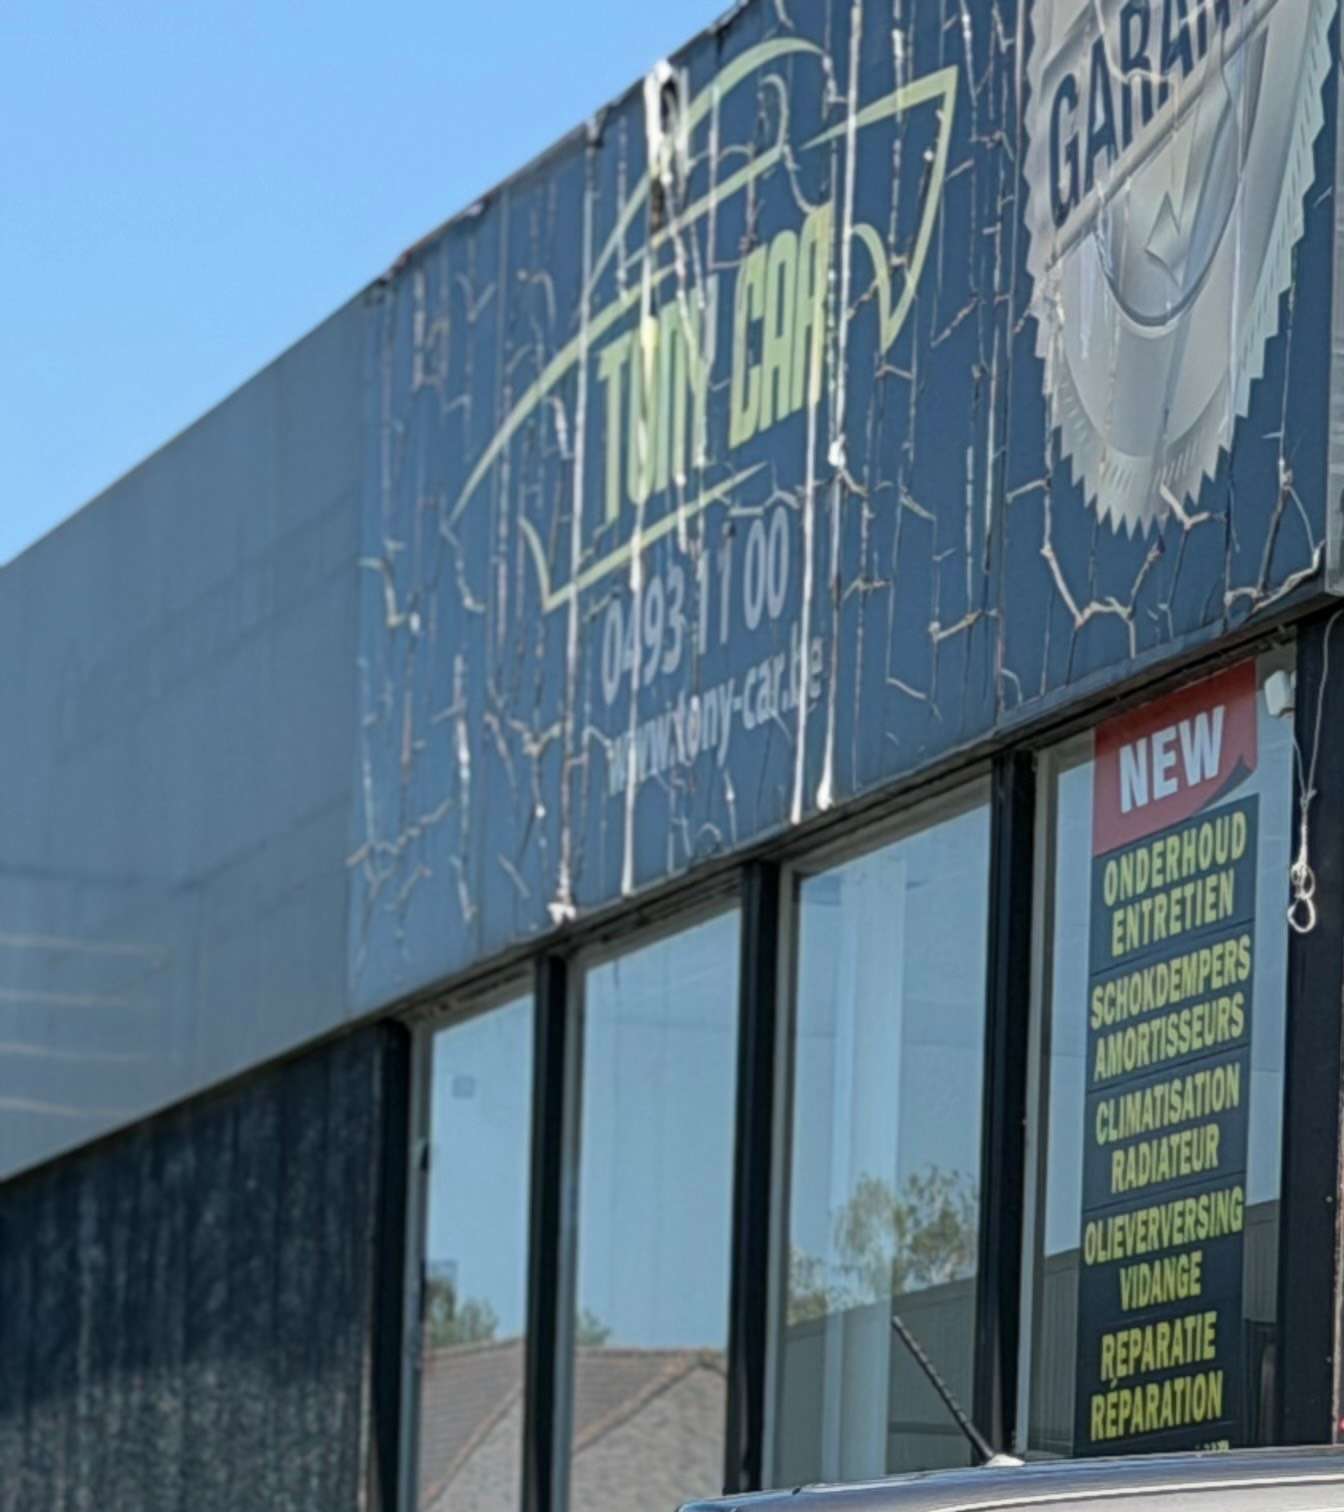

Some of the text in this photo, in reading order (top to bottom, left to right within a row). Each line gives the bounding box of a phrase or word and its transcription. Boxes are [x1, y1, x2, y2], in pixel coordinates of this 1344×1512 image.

[598, 202, 833, 525] TONY CAR
[1118, 705, 1225, 813] NEW
[1103, 811, 1247, 907] ONDERHOUD
[1112, 869, 1236, 957] ENTRETIEN
[1090, 934, 1252, 1030] SCHOKDEMPERS
[1094, 991, 1246, 1083] AMORTISSEURS
[1097, 1063, 1241, 1146] CLIMATISATION
[1111, 1123, 1221, 1195] RADIATEUR
[1084, 1186, 1244, 1267] OLIEVERVERSING
[1120, 1251, 1203, 1312] VIDANGE
[1101, 1311, 1218, 1382] REPARATIE
[1090, 1370, 1224, 1442] RÉPARATION
